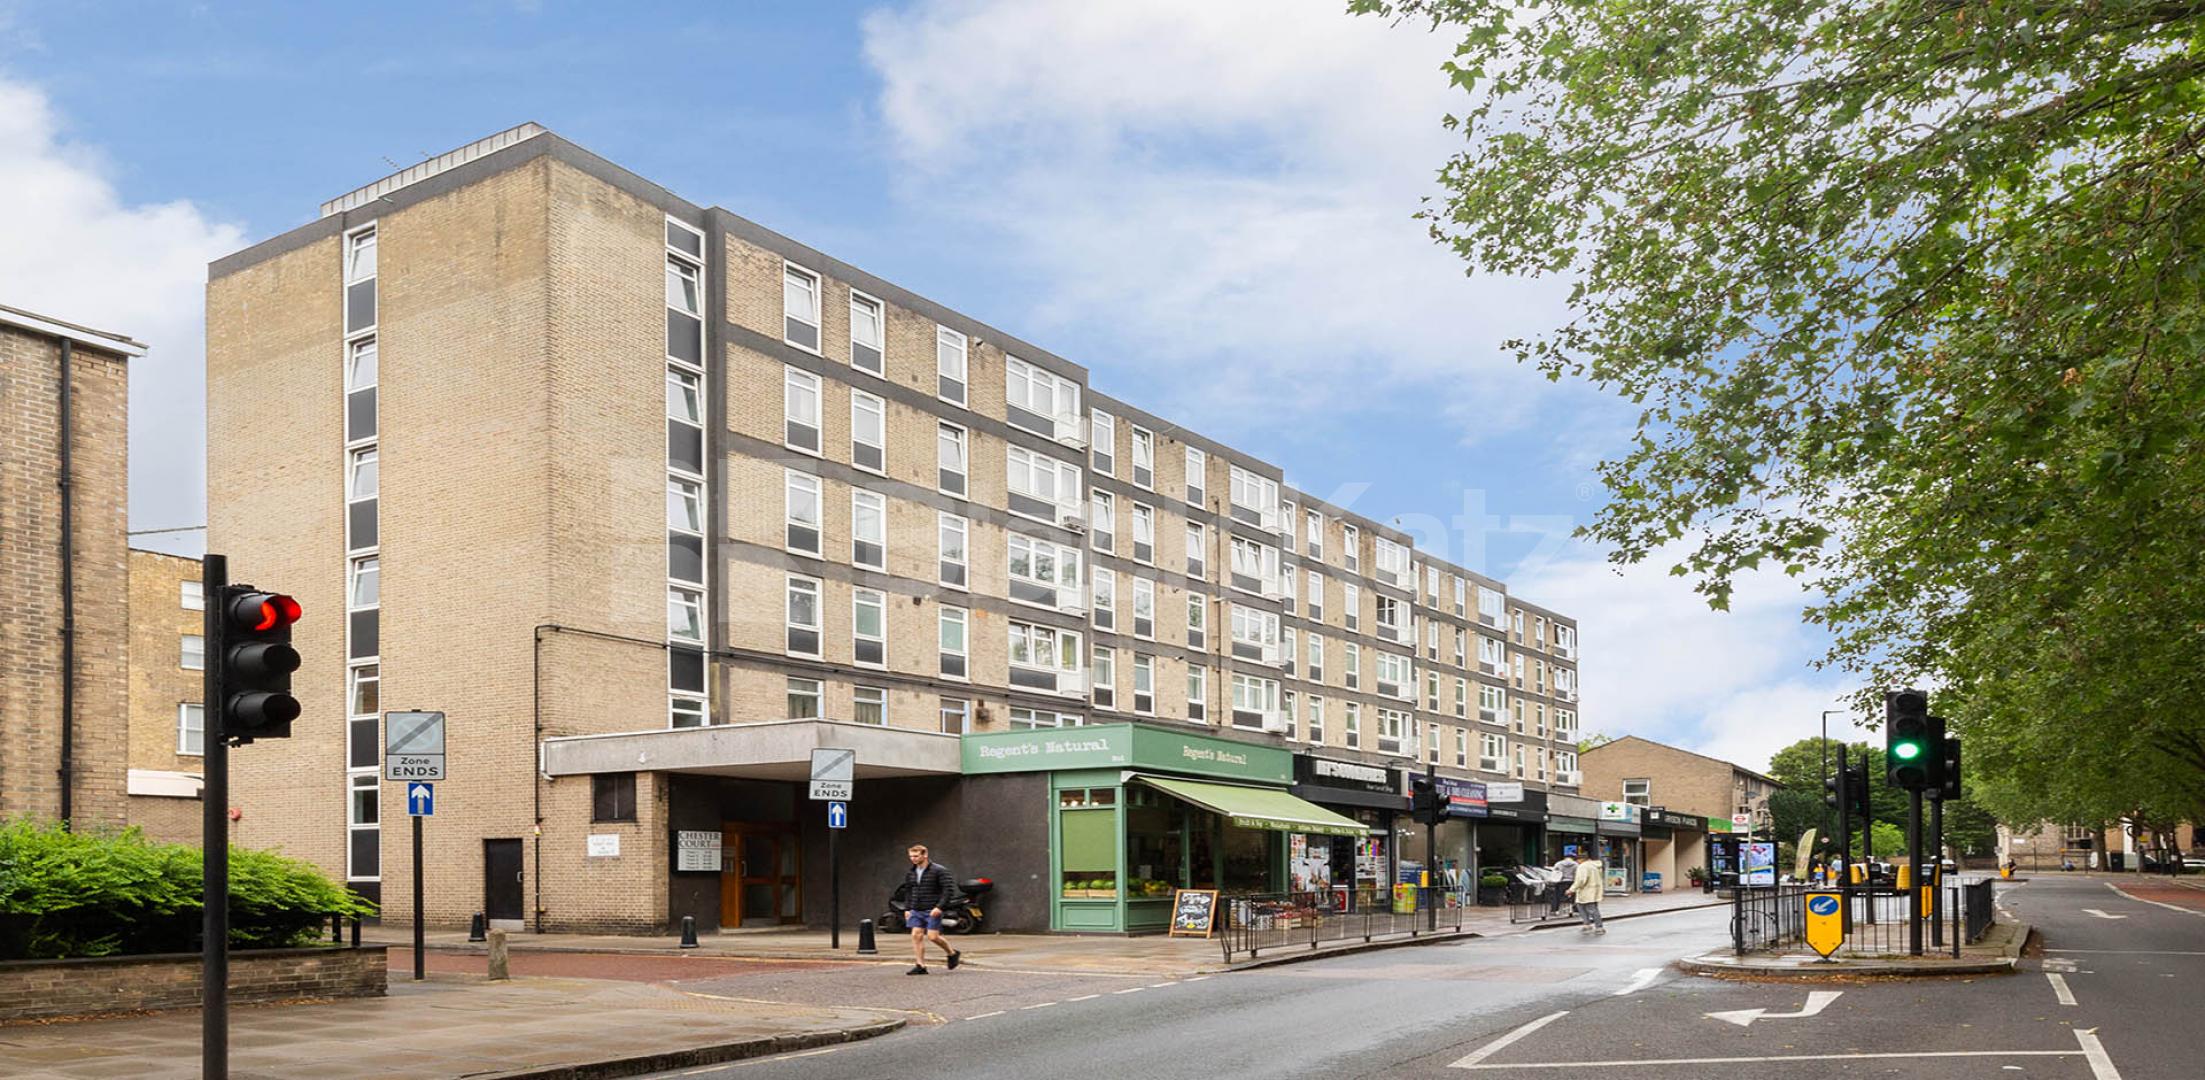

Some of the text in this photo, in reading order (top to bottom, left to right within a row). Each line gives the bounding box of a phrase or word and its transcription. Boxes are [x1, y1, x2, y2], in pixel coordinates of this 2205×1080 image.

[980, 738, 1110, 759] Regent's Natural
[1183, 745, 1247, 765] Regent's Natural
[400, 756, 431, 765] Zone
[393, 766, 438, 776] ENDS
[679, 832, 720, 840] CHESTER
[679, 840, 711, 848] COURT
